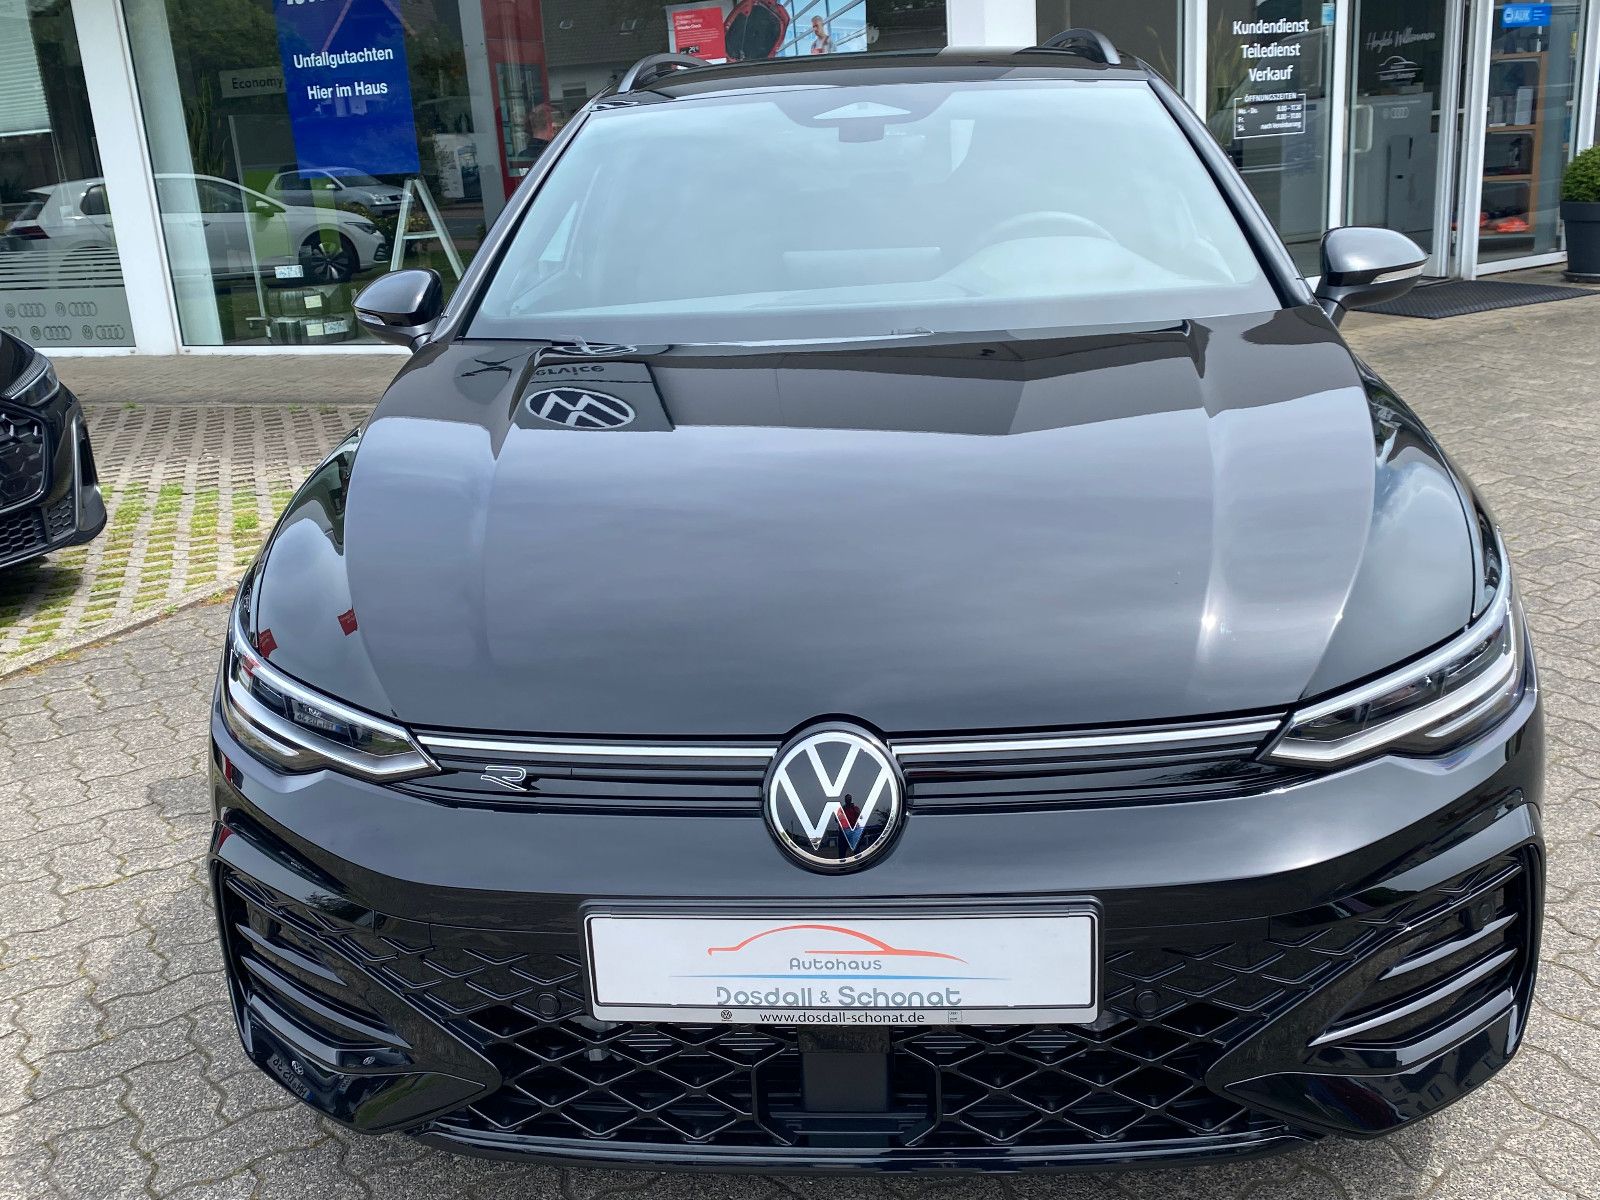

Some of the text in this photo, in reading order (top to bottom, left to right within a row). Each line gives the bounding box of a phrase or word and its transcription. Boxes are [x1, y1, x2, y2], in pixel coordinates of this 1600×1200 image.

[1232, 18, 1309, 35] Kundendienst
[293, 47, 394, 69] Unfallgutachten
[1240, 43, 1301, 58] Teiledienst
[1248, 65, 1293, 81] Verkauf
[232, 77, 284, 90] Economy
[307, 81, 388, 100] Hier im Haus
[1244, 92, 1297, 102] ÖFFNUNGSZEITEN
[789, 957, 883, 971] Autohaus
[716, 985, 962, 1006] Dosdall & Schonat
[759, 1011, 926, 1024] www.dosdall-schonat.de
